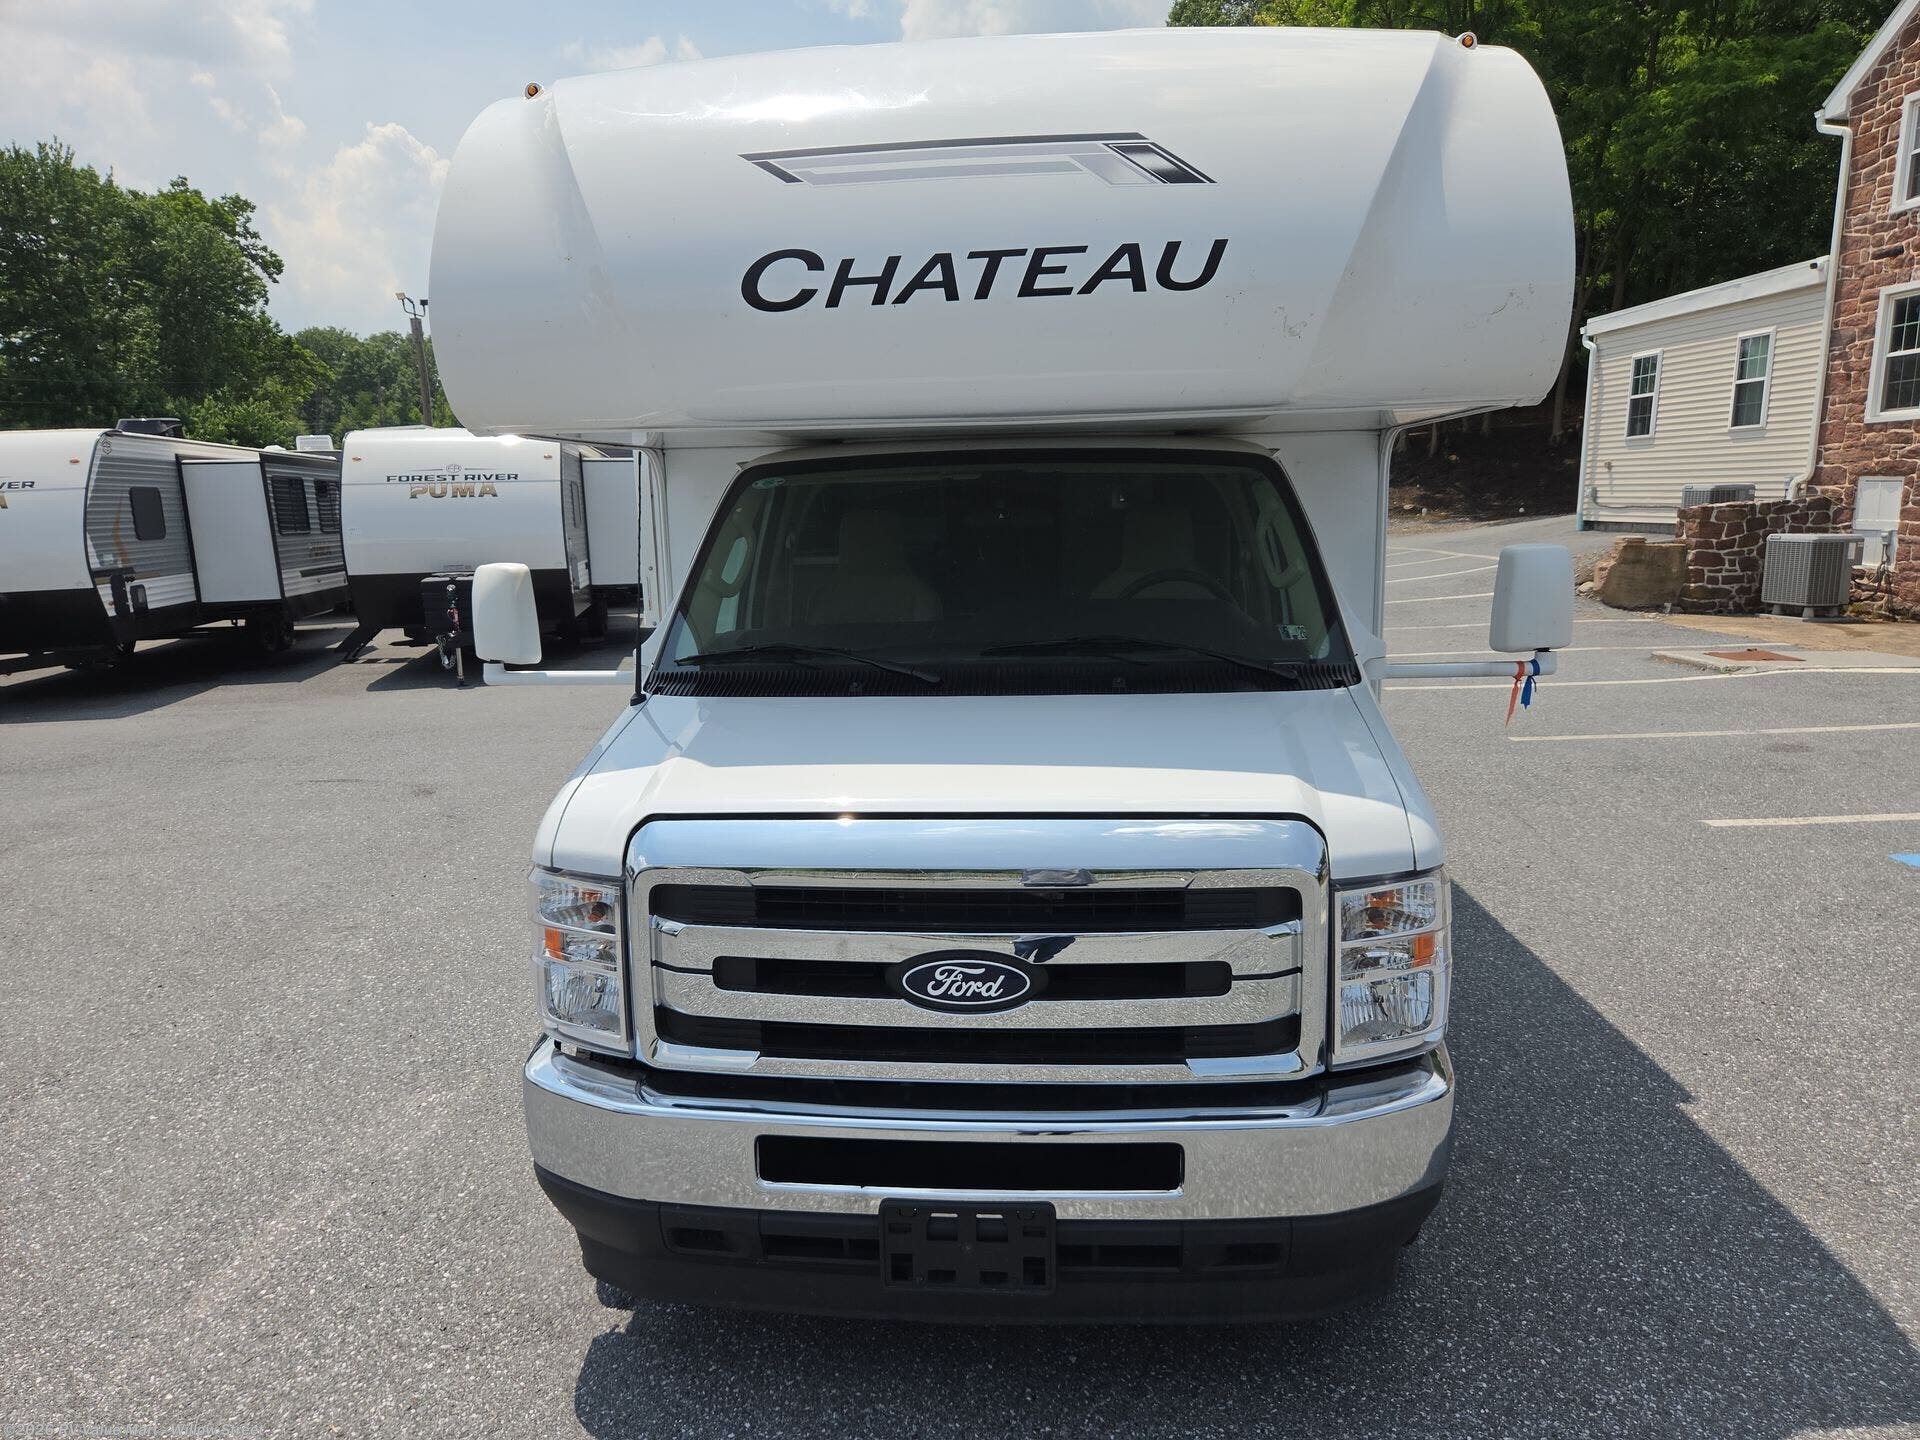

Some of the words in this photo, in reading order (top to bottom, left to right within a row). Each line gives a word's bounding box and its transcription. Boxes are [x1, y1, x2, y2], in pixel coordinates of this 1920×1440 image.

[386, 474, 459, 482] FOREST
[464, 473, 519, 481] RIVER
[409, 482, 498, 499] PUMA
[927, 965, 1005, 998] Ford
